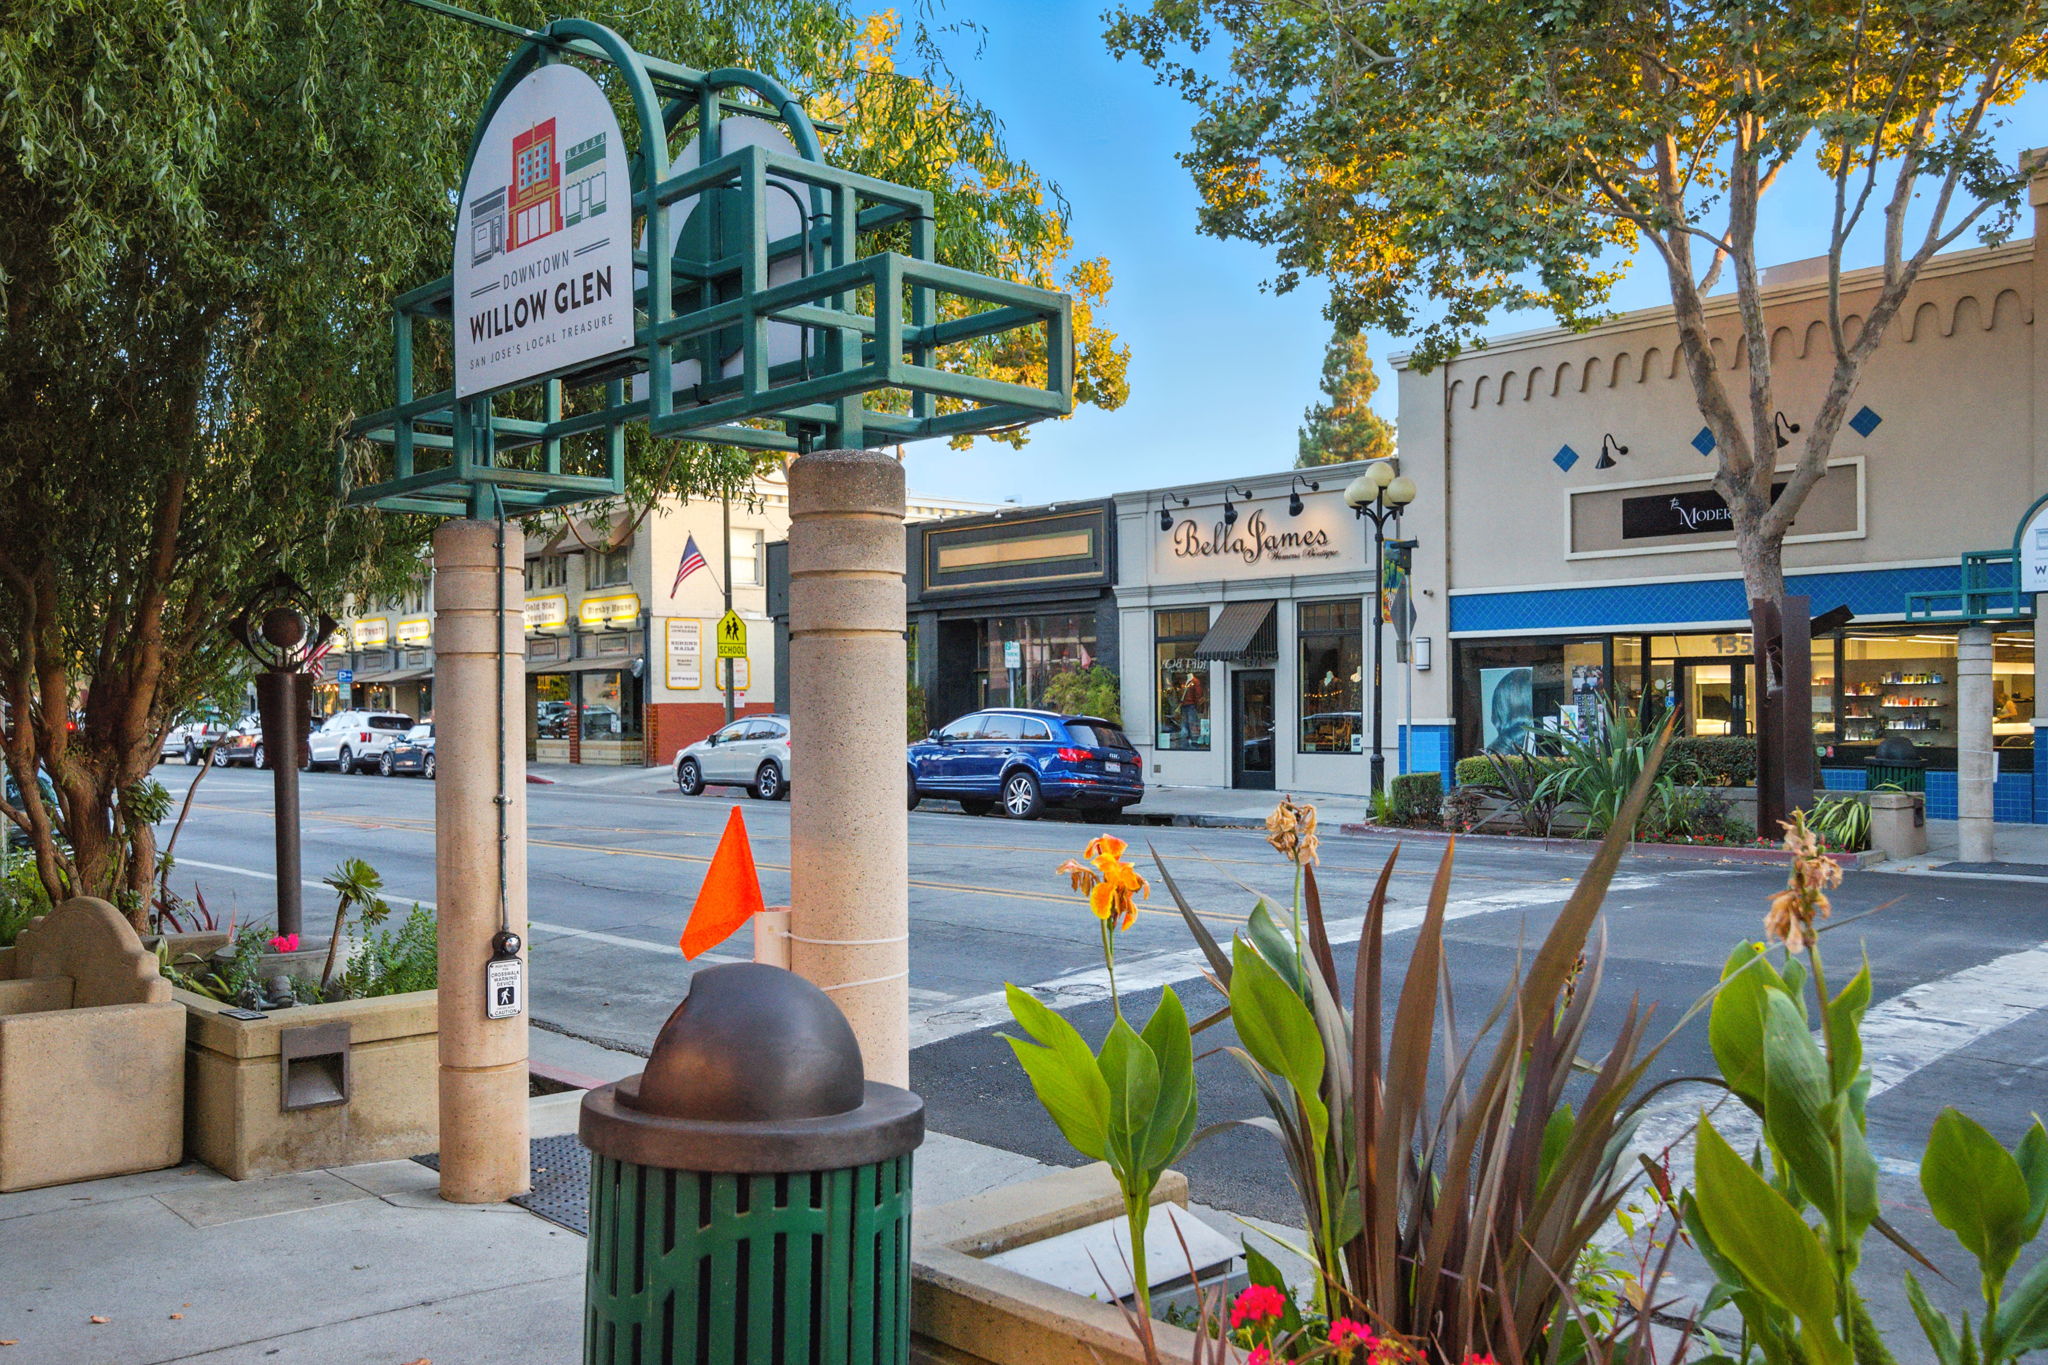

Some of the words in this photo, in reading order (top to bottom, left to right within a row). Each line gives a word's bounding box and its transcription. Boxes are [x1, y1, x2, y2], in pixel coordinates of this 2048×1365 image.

[503, 249, 570, 290] DOWNTOWN
[470, 289, 547, 345] WILLOW
[554, 265, 612, 314] GLEN
[470, 359, 486, 370] SAN
[490, 344, 521, 364] JOSE'S
[526, 333, 557, 351] LOCAL
[562, 313, 613, 340] TREASURE
[1673, 506, 1732, 530] MODER
[1174, 519, 1247, 558] Bella
[1243, 508, 1329, 564] James
[719, 645, 746, 655] SCHOOL
[1712, 635, 1753, 654] 135
[491, 970, 519, 978] CROSSWALK
